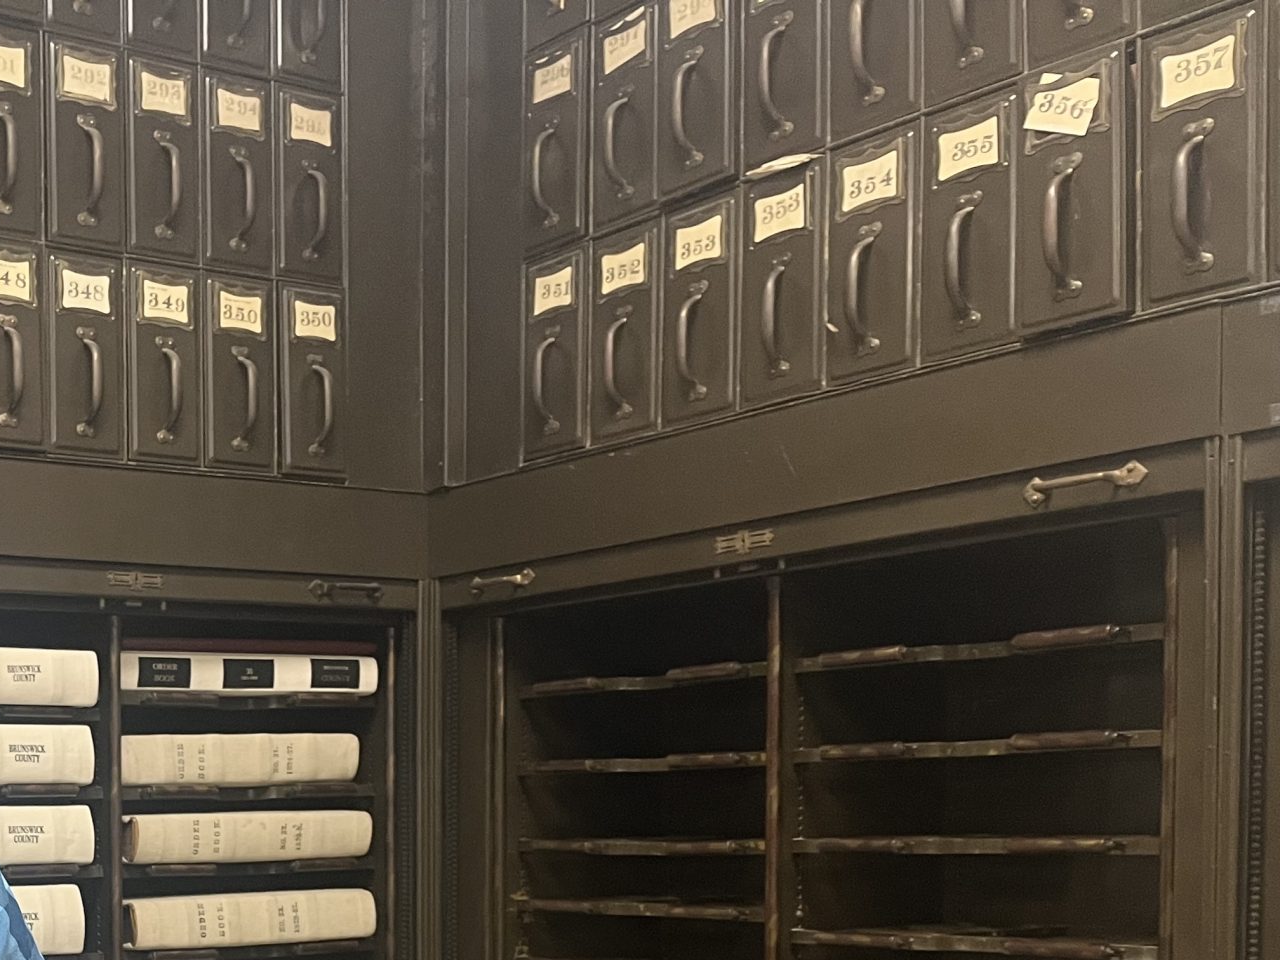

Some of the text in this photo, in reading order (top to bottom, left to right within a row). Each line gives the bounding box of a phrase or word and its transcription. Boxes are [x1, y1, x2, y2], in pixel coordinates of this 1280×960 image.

[1173, 43, 1230, 84] 357
[1038, 92, 1086, 120] 356
[951, 134, 994, 162] 355
[849, 173, 894, 198] 354
[761, 193, 801, 225] 353
[680, 234, 716, 260] 353
[605, 259, 641, 283] 352
[68, 281, 105, 302] 348
[541, 280, 572, 299] 351
[148, 292, 185, 313] 349
[223, 303, 258, 324] 350
[299, 310, 332, 328] 350
[6, 664, 42, 674] BRUNSWICK
[12, 674, 36, 682] COUNTY
[8, 744, 46, 754] BRUNSWICK
[14, 754, 40, 763] COUNTY
[8, 826, 45, 834] BRUNSWICK
[14, 834, 40, 844] COUNTY
